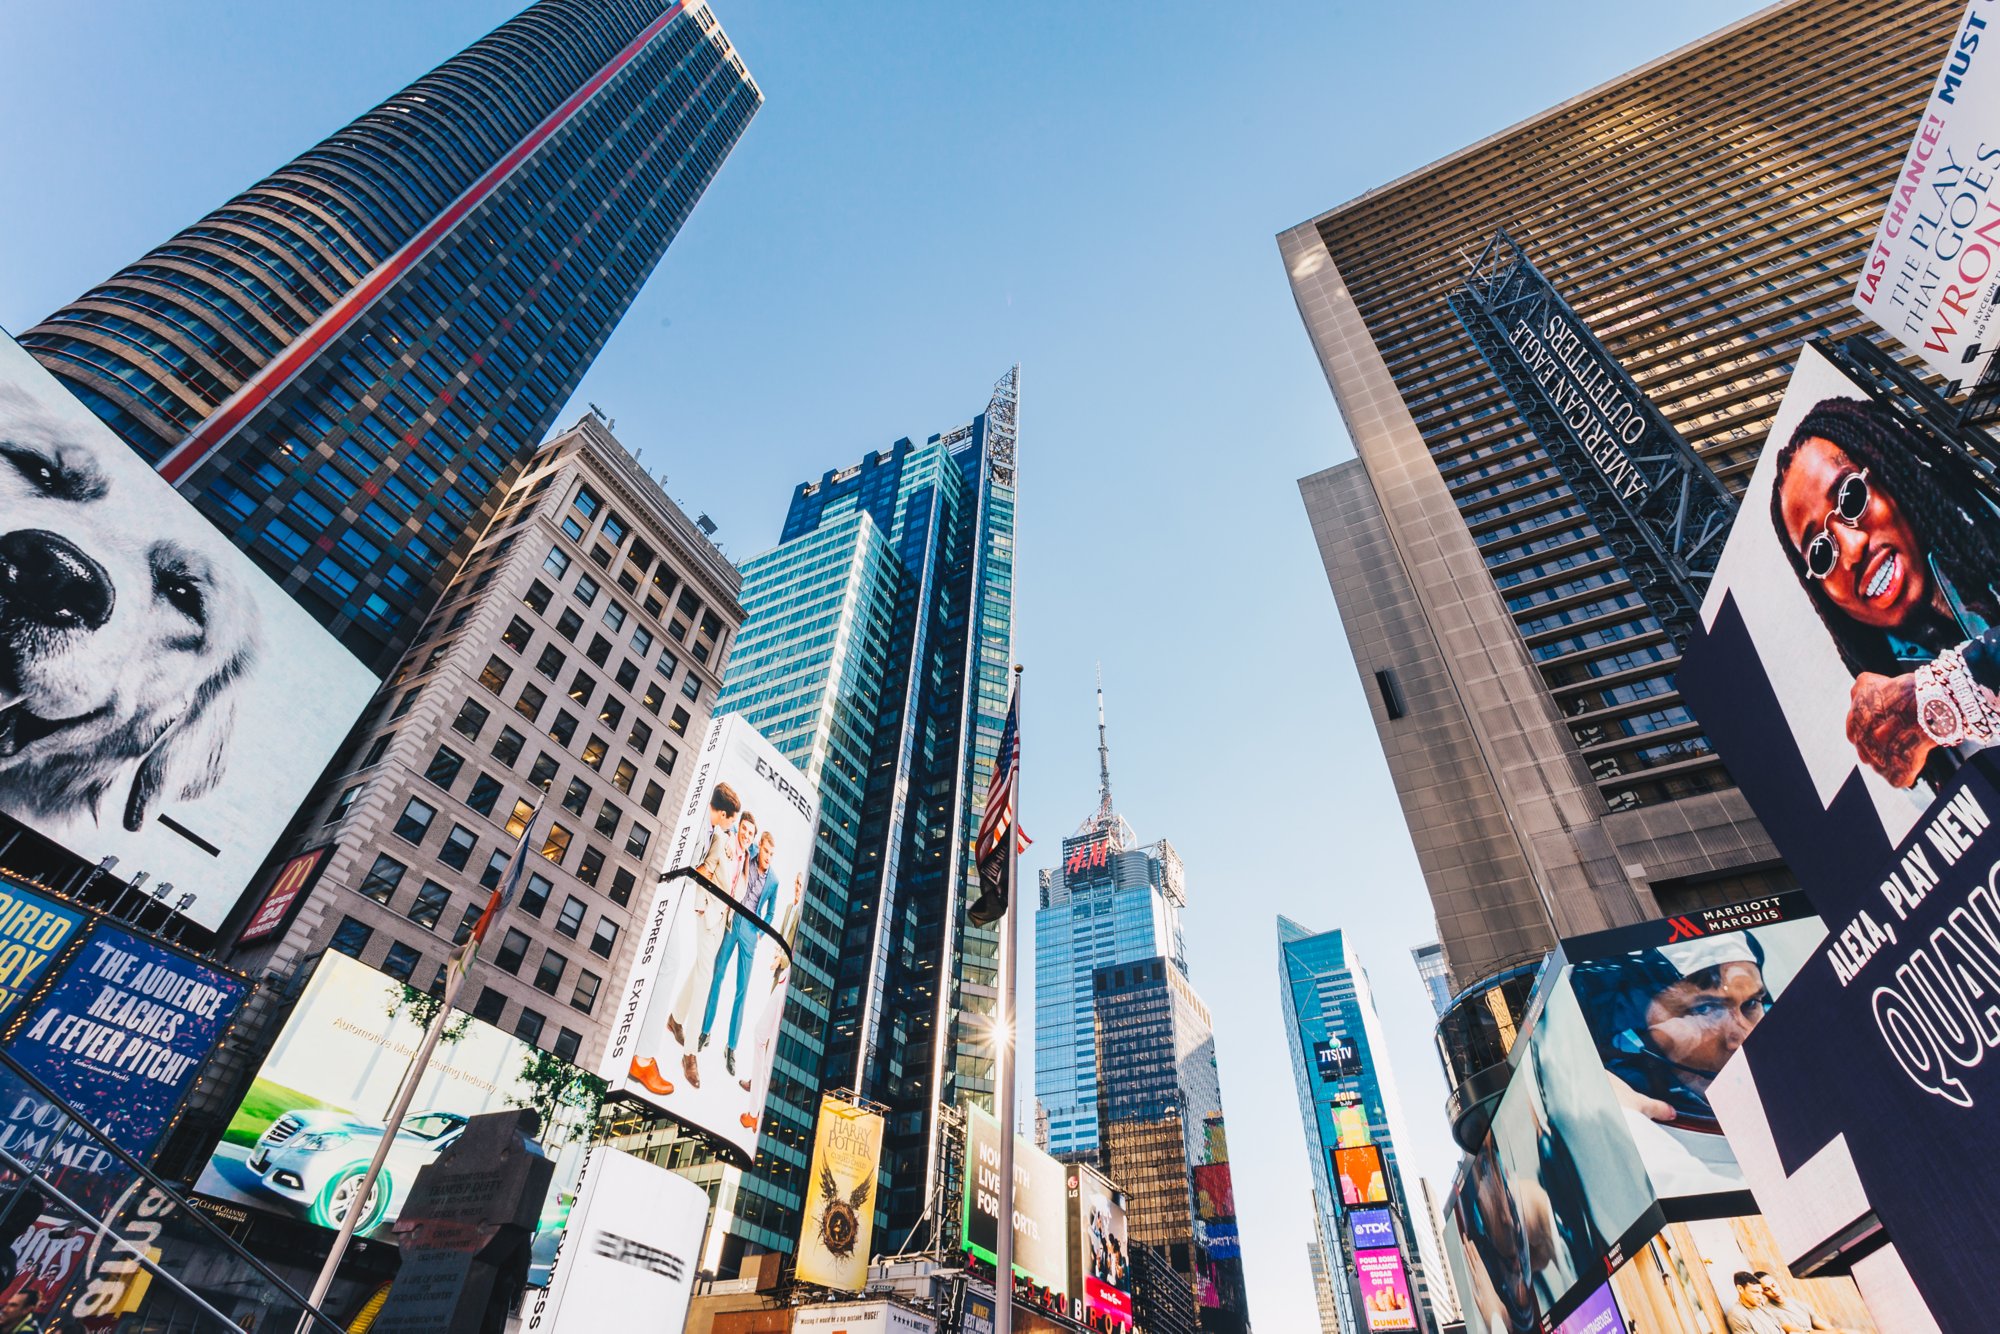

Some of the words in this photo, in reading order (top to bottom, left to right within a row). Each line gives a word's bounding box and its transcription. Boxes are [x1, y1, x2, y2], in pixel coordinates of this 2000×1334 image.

[1860, 240, 1891, 304] LAST
[1886, 114, 1945, 238] CHANCE!
[1938, 11, 1987, 104] MUST
[1890, 255, 1920, 306] THE
[1909, 147, 1964, 250] PLAY
[1904, 263, 1940, 333] THAT
[1976, 282, 1998, 319] LYCEUM
[1508, 319, 1559, 388] EAGLE
[1975, 324, 1986, 340] 149
[1543, 314, 1646, 445] OUTFITTERS
[1549, 376, 1648, 500] AMERICAN
[687, 762, 710, 817] EXPRESS
[1066, 838, 1108, 875] H&M
[257, 903, 285, 924] 24
[265, 892, 296, 908] OPEN
[1703, 898, 1780, 920] MARRIOTT
[1827, 909, 1898, 987] ALEXA,
[1880, 843, 1940, 921] PLAY
[1924, 784, 1991, 866] NEW
[243, 918, 281, 937] HOURS
[641, 899, 668, 965] EXPRESS
[1708, 910, 1779, 931] MARQUIS
[128, 962, 228, 1021] AUDIENCE
[1872, 860, 2000, 1107] QUAV
[27, 1008, 60, 1041] A
[47, 1014, 126, 1065] FEVER
[87, 985, 185, 1042] REACHES
[612, 978, 645, 1059] EXPRESS
[332, 1016, 392, 1049] Automotive
[462, 1070, 498, 1095] Industry
[0, 1120, 113, 1176] UMMER
[828, 1129, 872, 1160] POTTER
[832, 1115, 872, 1141] HARRY
[1069, 1190, 1078, 1198] LG
[1365, 1222, 1391, 1234] TDK
